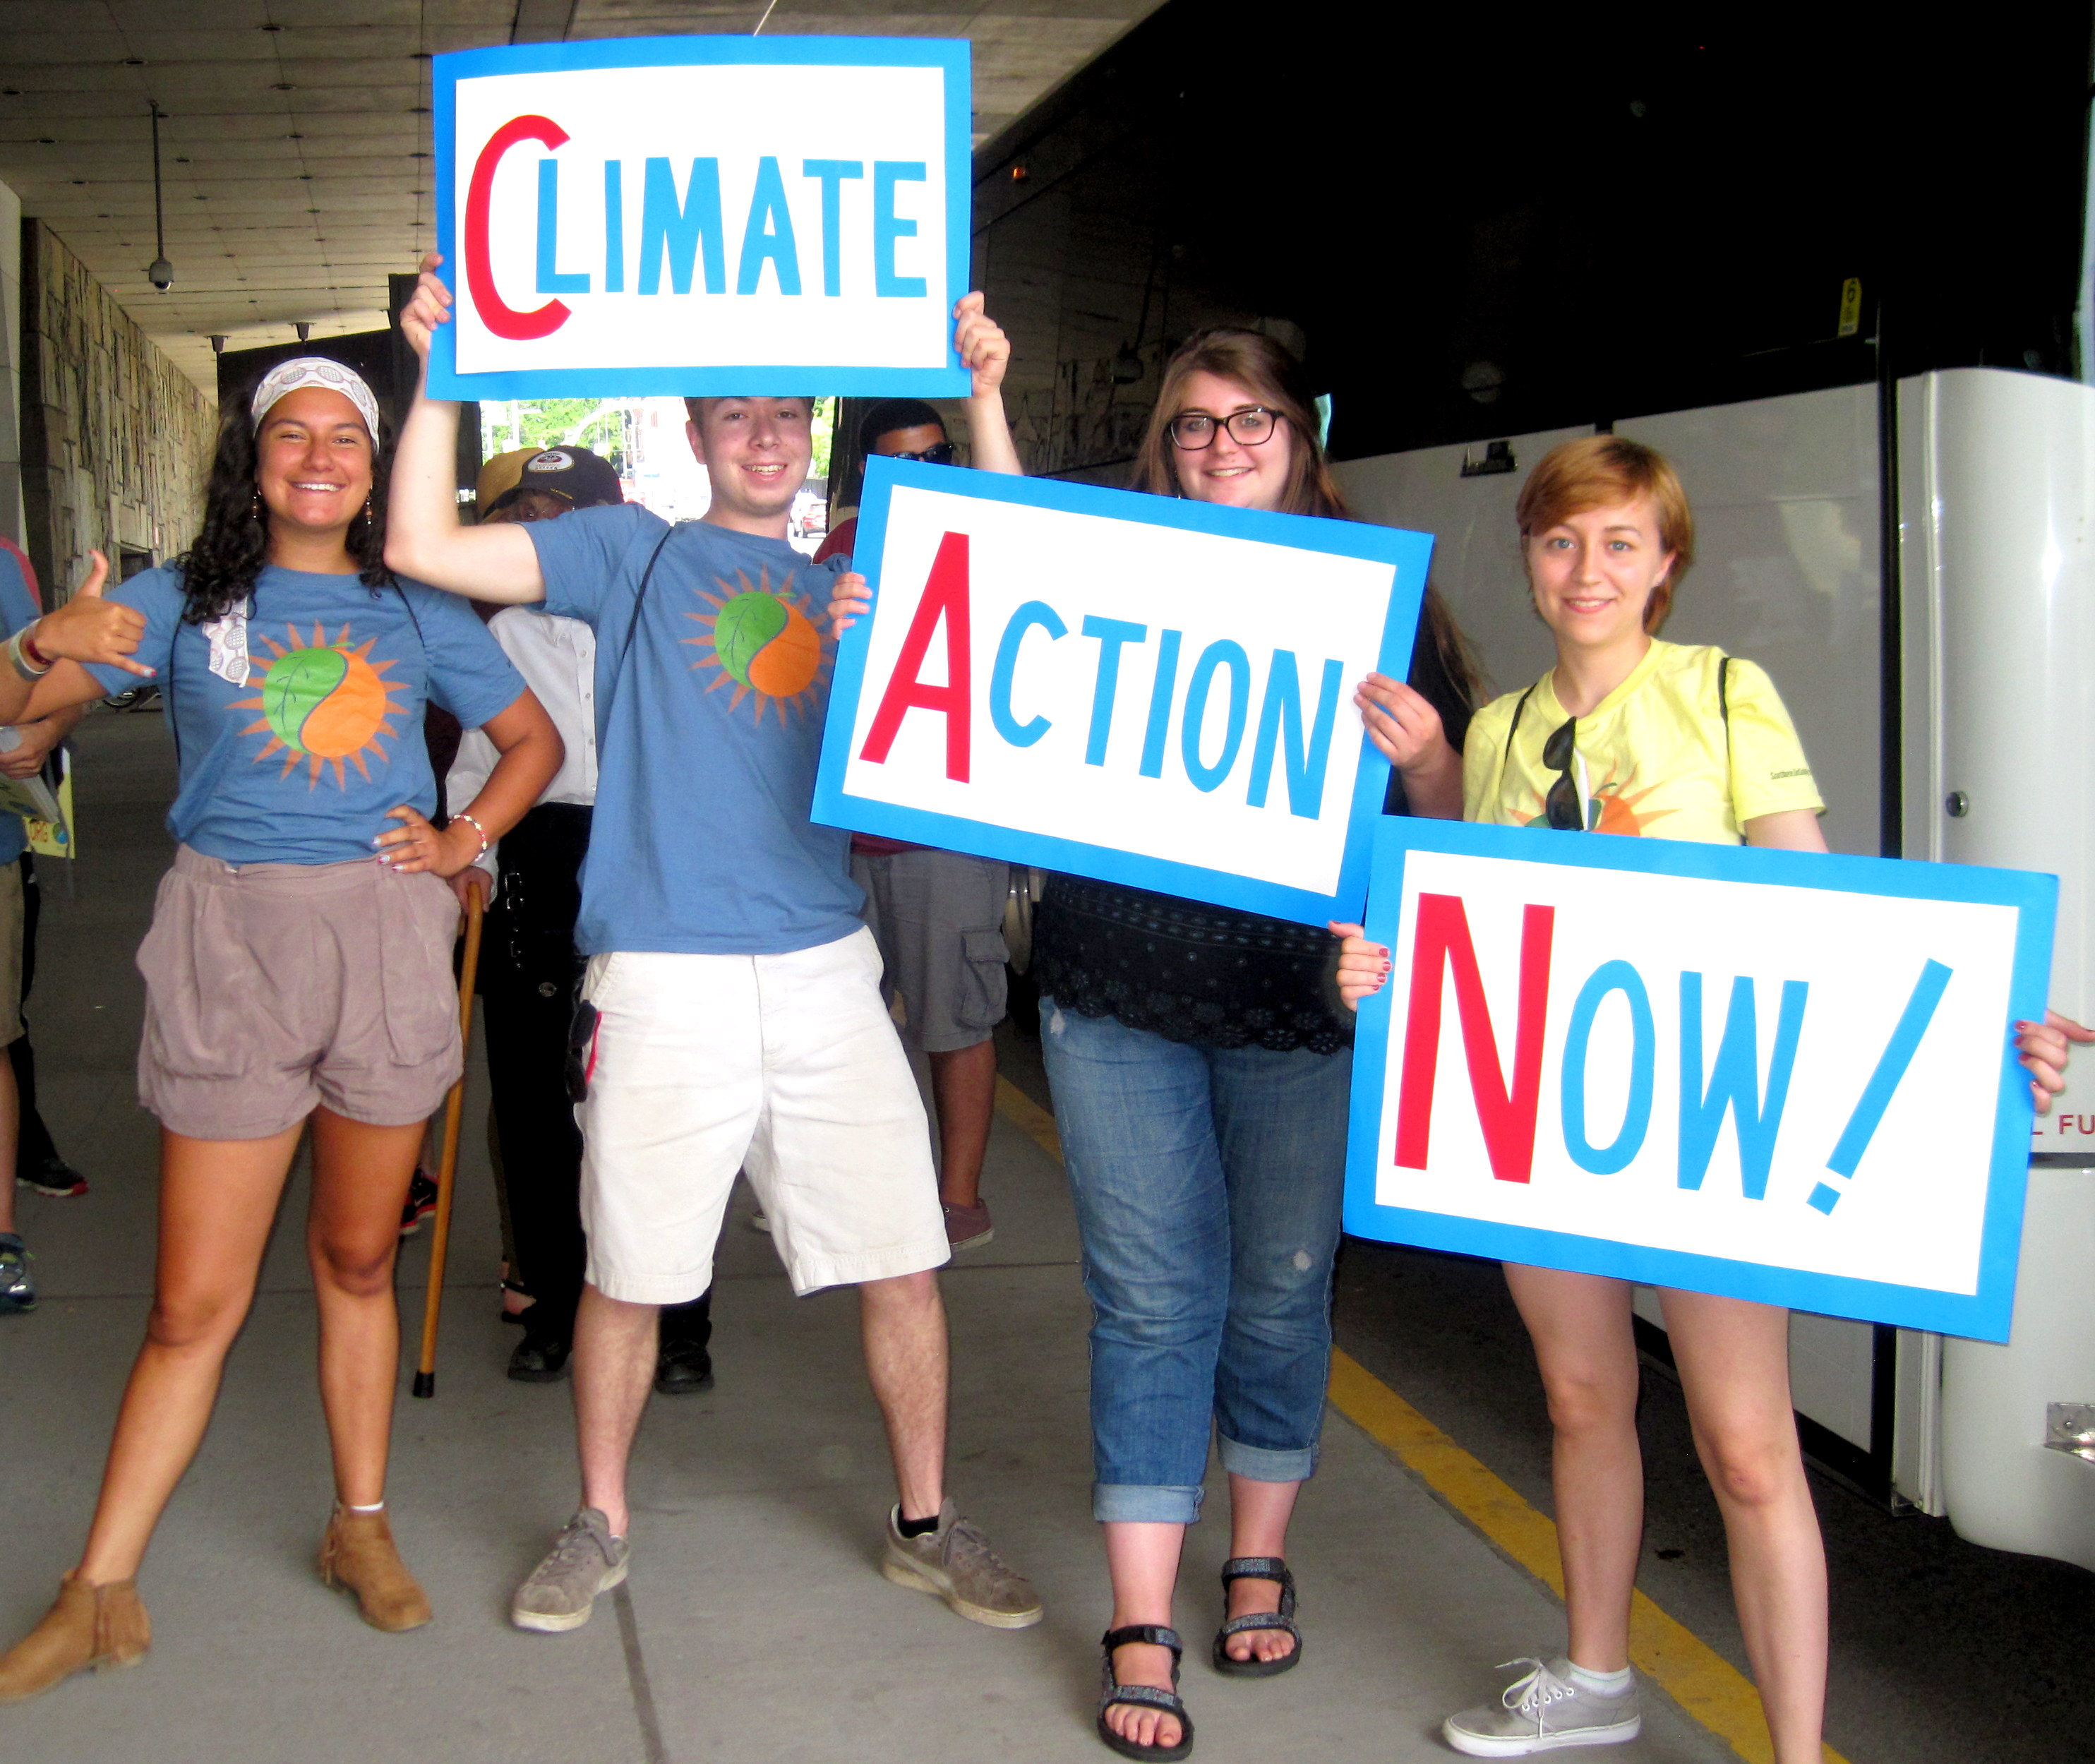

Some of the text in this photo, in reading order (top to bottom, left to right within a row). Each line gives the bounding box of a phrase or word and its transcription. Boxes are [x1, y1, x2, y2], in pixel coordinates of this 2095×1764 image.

[464, 114, 926, 340] CLIMATE
[860, 532, 1343, 820] ACTION
[1395, 893, 1953, 1215] NOW!
